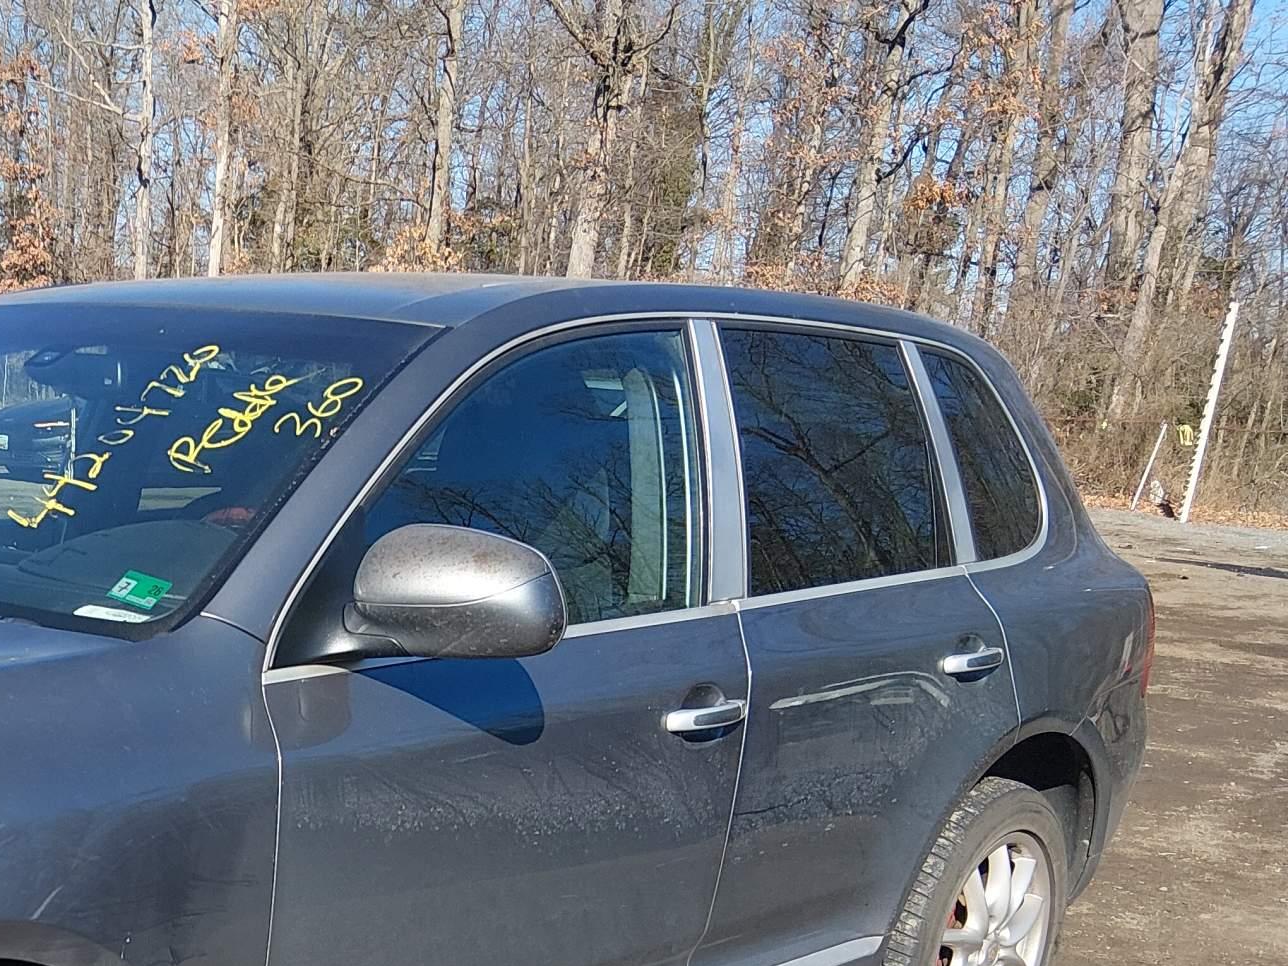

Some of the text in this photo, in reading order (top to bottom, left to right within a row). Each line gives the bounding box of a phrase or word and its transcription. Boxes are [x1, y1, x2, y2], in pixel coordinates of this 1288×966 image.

[7, 344, 220, 528] 44204720
[274, 377, 364, 439] 360
[147, 584, 165, 597] 26
